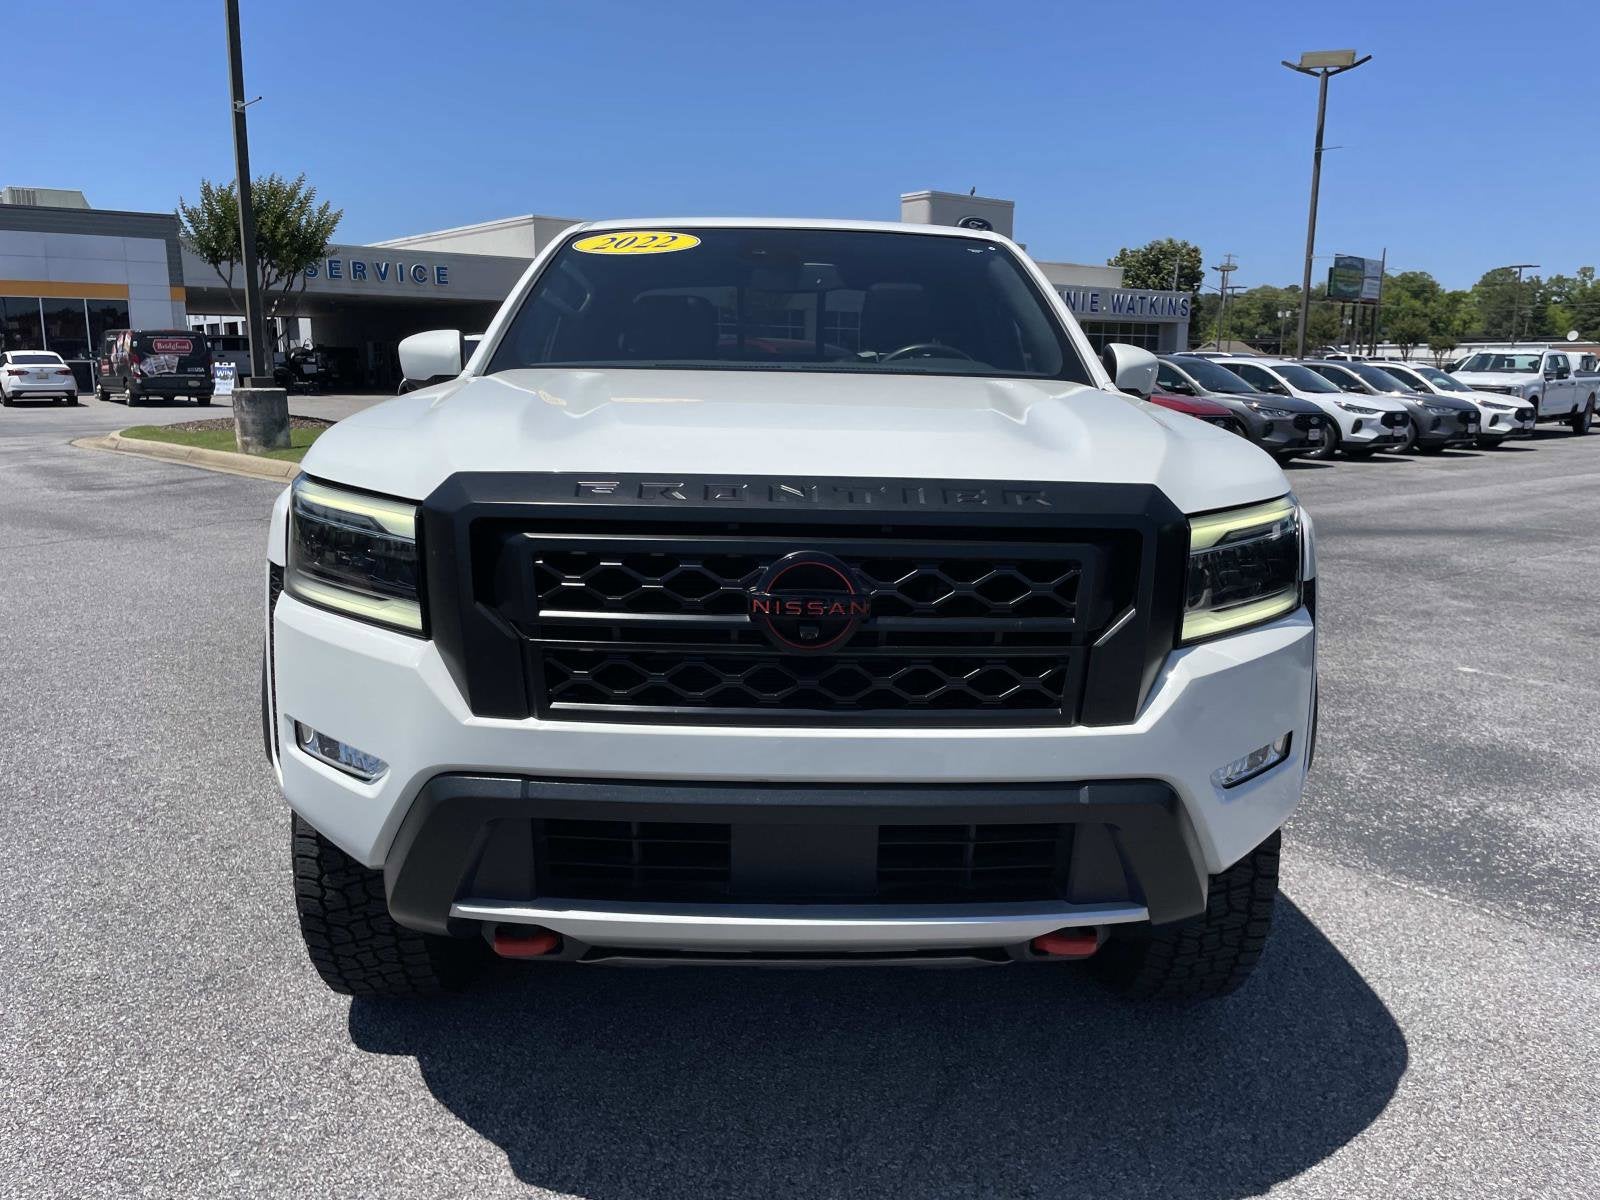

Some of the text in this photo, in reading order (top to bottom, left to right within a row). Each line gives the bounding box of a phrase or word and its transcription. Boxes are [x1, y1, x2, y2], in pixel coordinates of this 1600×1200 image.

[591, 235, 678, 250] 2022
[1057, 290, 1189, 317] NIE WATKINS
[575, 480, 1052, 506] FRONTIER
[752, 599, 869, 615] NISSAN
